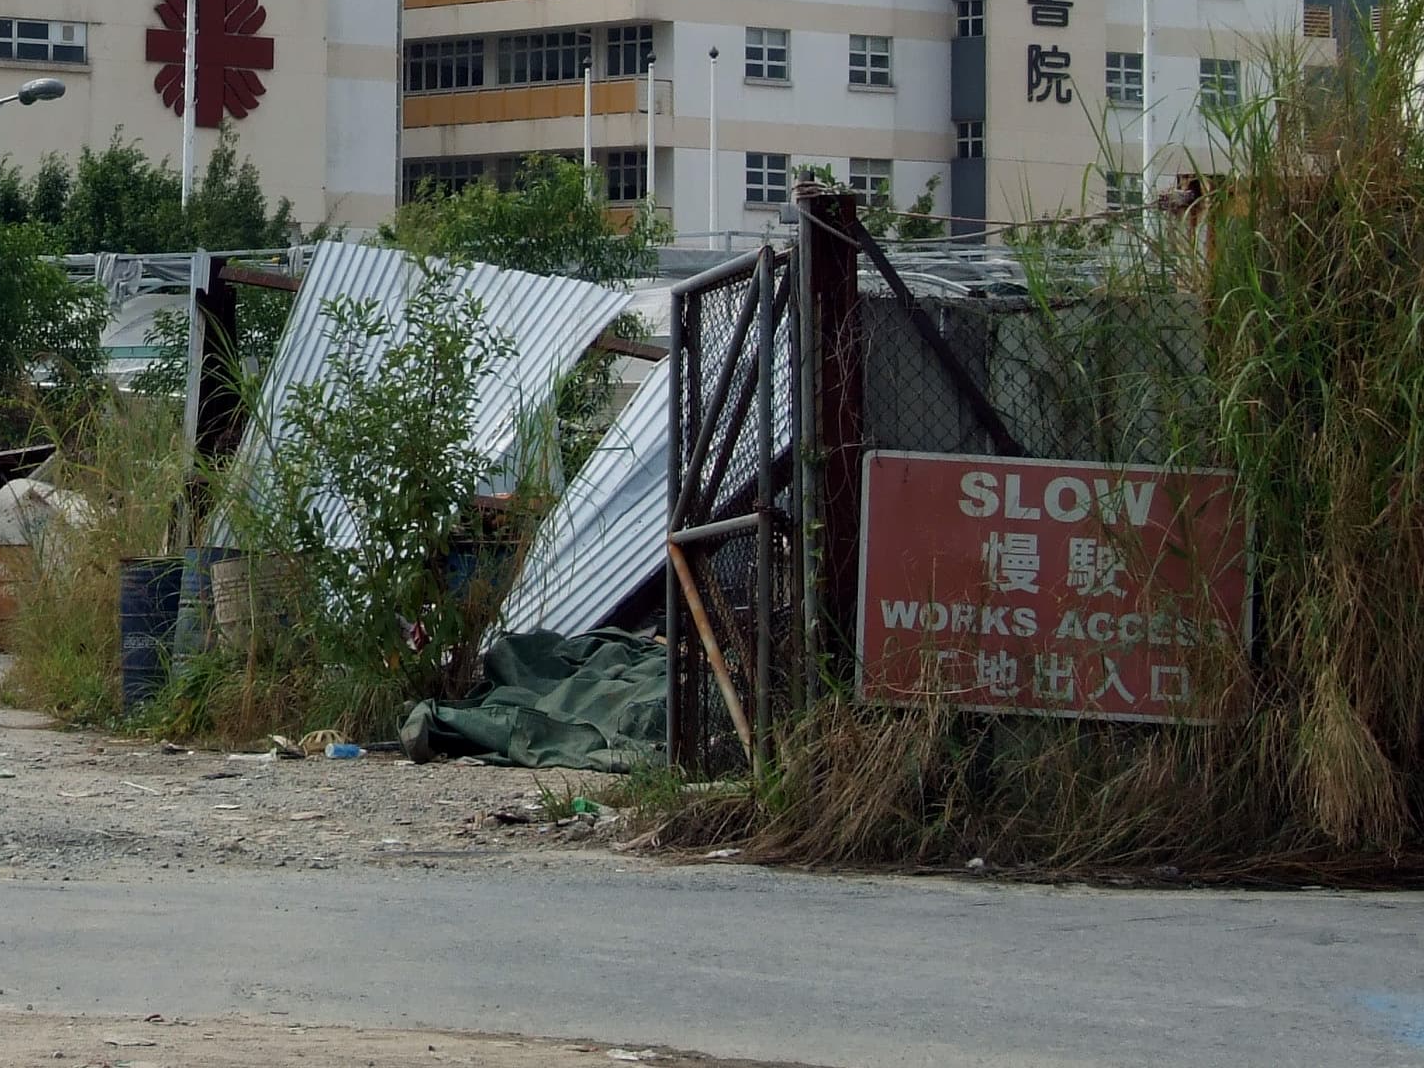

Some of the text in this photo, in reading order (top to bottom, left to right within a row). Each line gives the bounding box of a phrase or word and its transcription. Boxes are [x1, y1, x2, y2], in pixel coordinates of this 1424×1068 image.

[958, 472, 1156, 526] SLOW
[981, 531, 1127, 599] 慢駛
[880, 599, 1038, 638] WORKS
